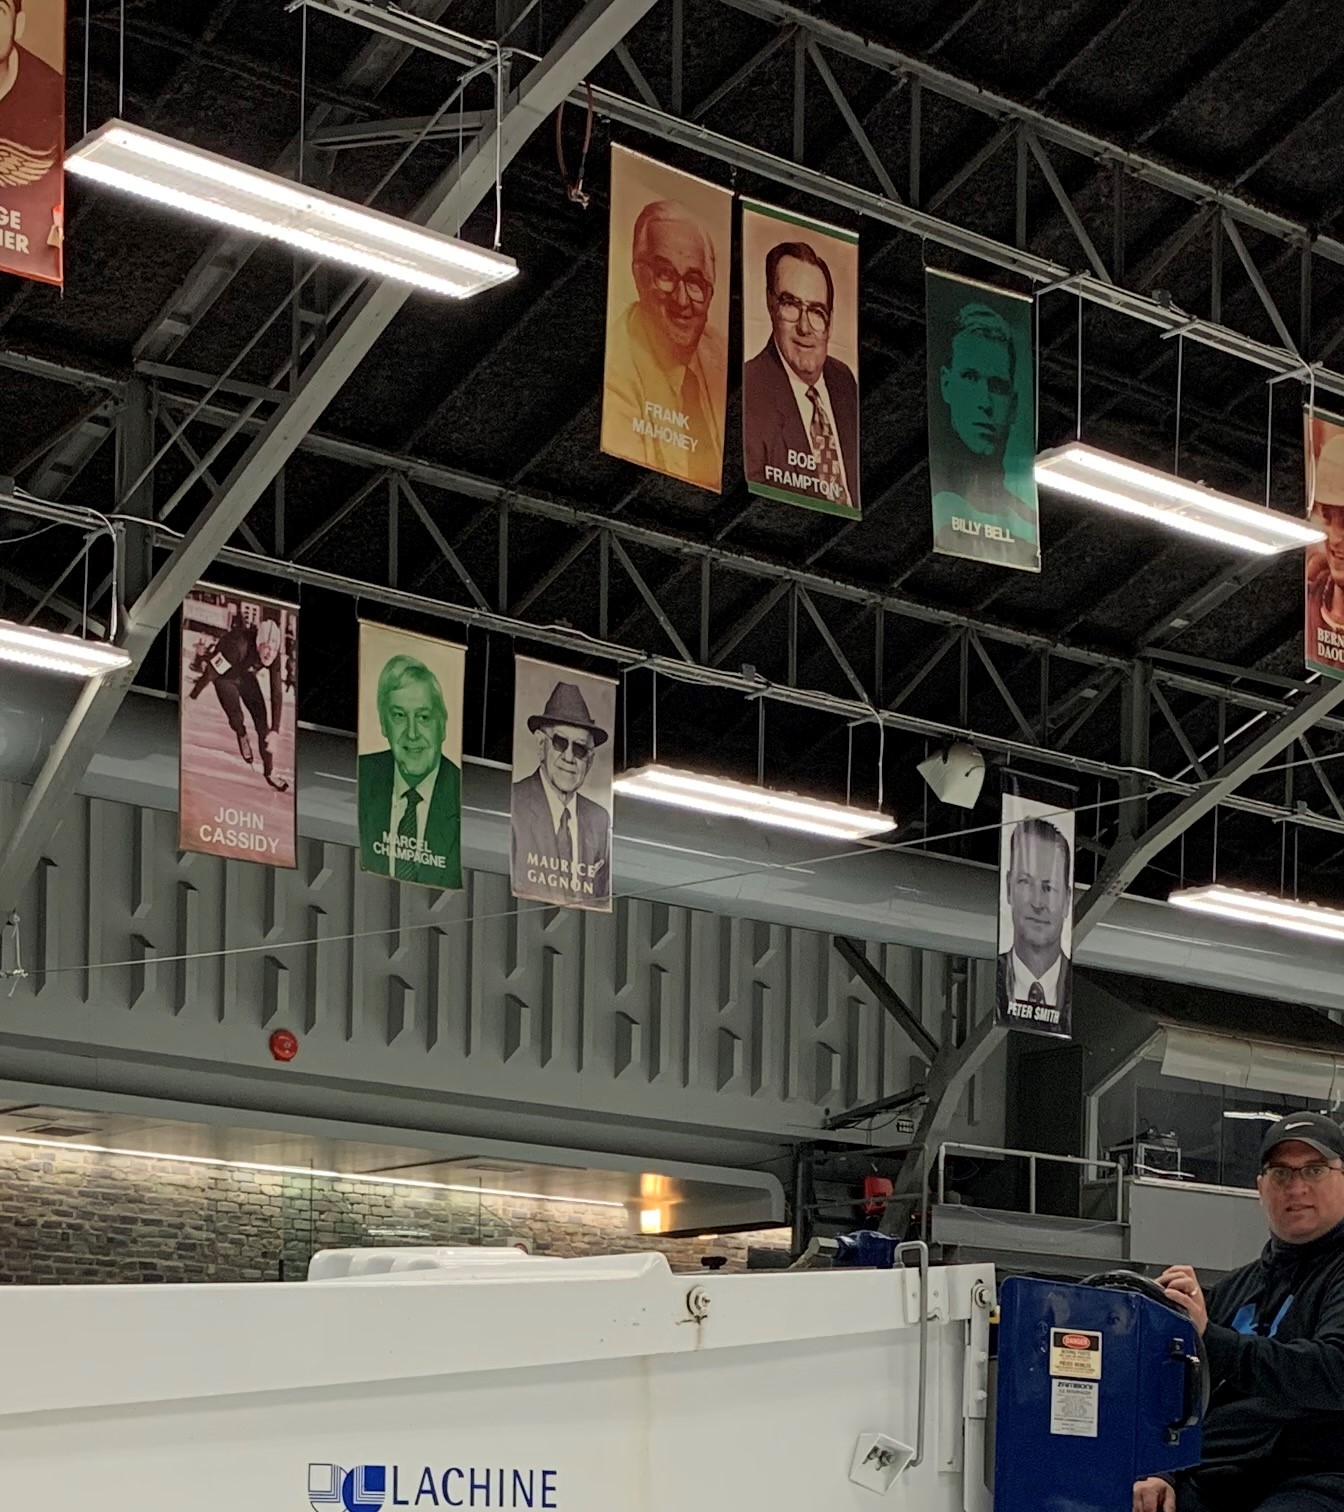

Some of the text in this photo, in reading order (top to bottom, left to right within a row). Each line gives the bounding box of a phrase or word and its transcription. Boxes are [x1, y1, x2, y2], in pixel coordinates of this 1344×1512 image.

[644, 400, 690, 430] FRANK
[632, 417, 698, 453] MAHONEY
[787, 449, 817, 471] BOB
[765, 465, 840, 498] FRAMPTON
[951, 516, 1015, 543] BILLY BELL
[214, 807, 264, 831] JOHN
[199, 824, 279, 854] CASSIDY
[382, 831, 432, 853] MARCEL
[373, 841, 446, 868] CHAMPAGNE
[527, 852, 596, 878] MAURICE
[527, 869, 594, 895] GAGNON
[1007, 1001, 1060, 1024] PETER SMITH
[392, 1465, 558, 1508] LACHINE
